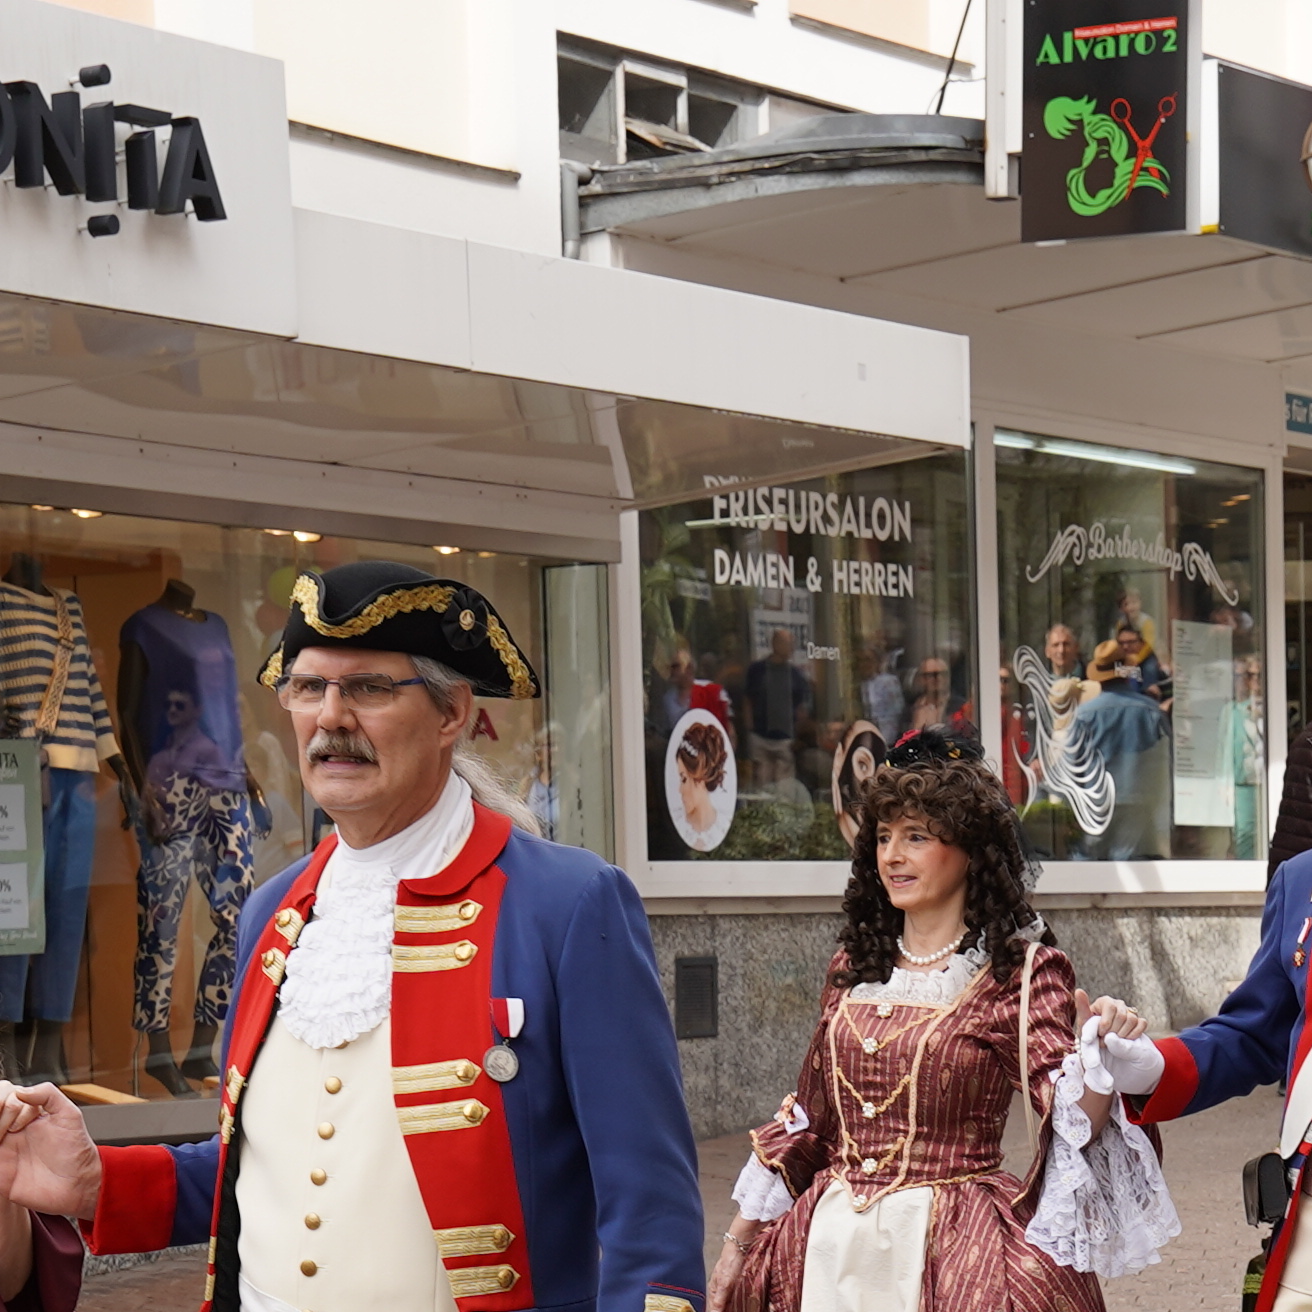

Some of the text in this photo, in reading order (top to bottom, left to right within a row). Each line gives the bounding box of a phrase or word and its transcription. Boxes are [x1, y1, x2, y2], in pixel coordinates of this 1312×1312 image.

[1036, 29, 1177, 66] Alvaro 2
[713, 486, 913, 543] FRISEURSALON
[714, 549, 914, 598] DAMEN & HERREN
[1088, 522, 1183, 581] Barbershop
[807, 641, 841, 660] Damen
